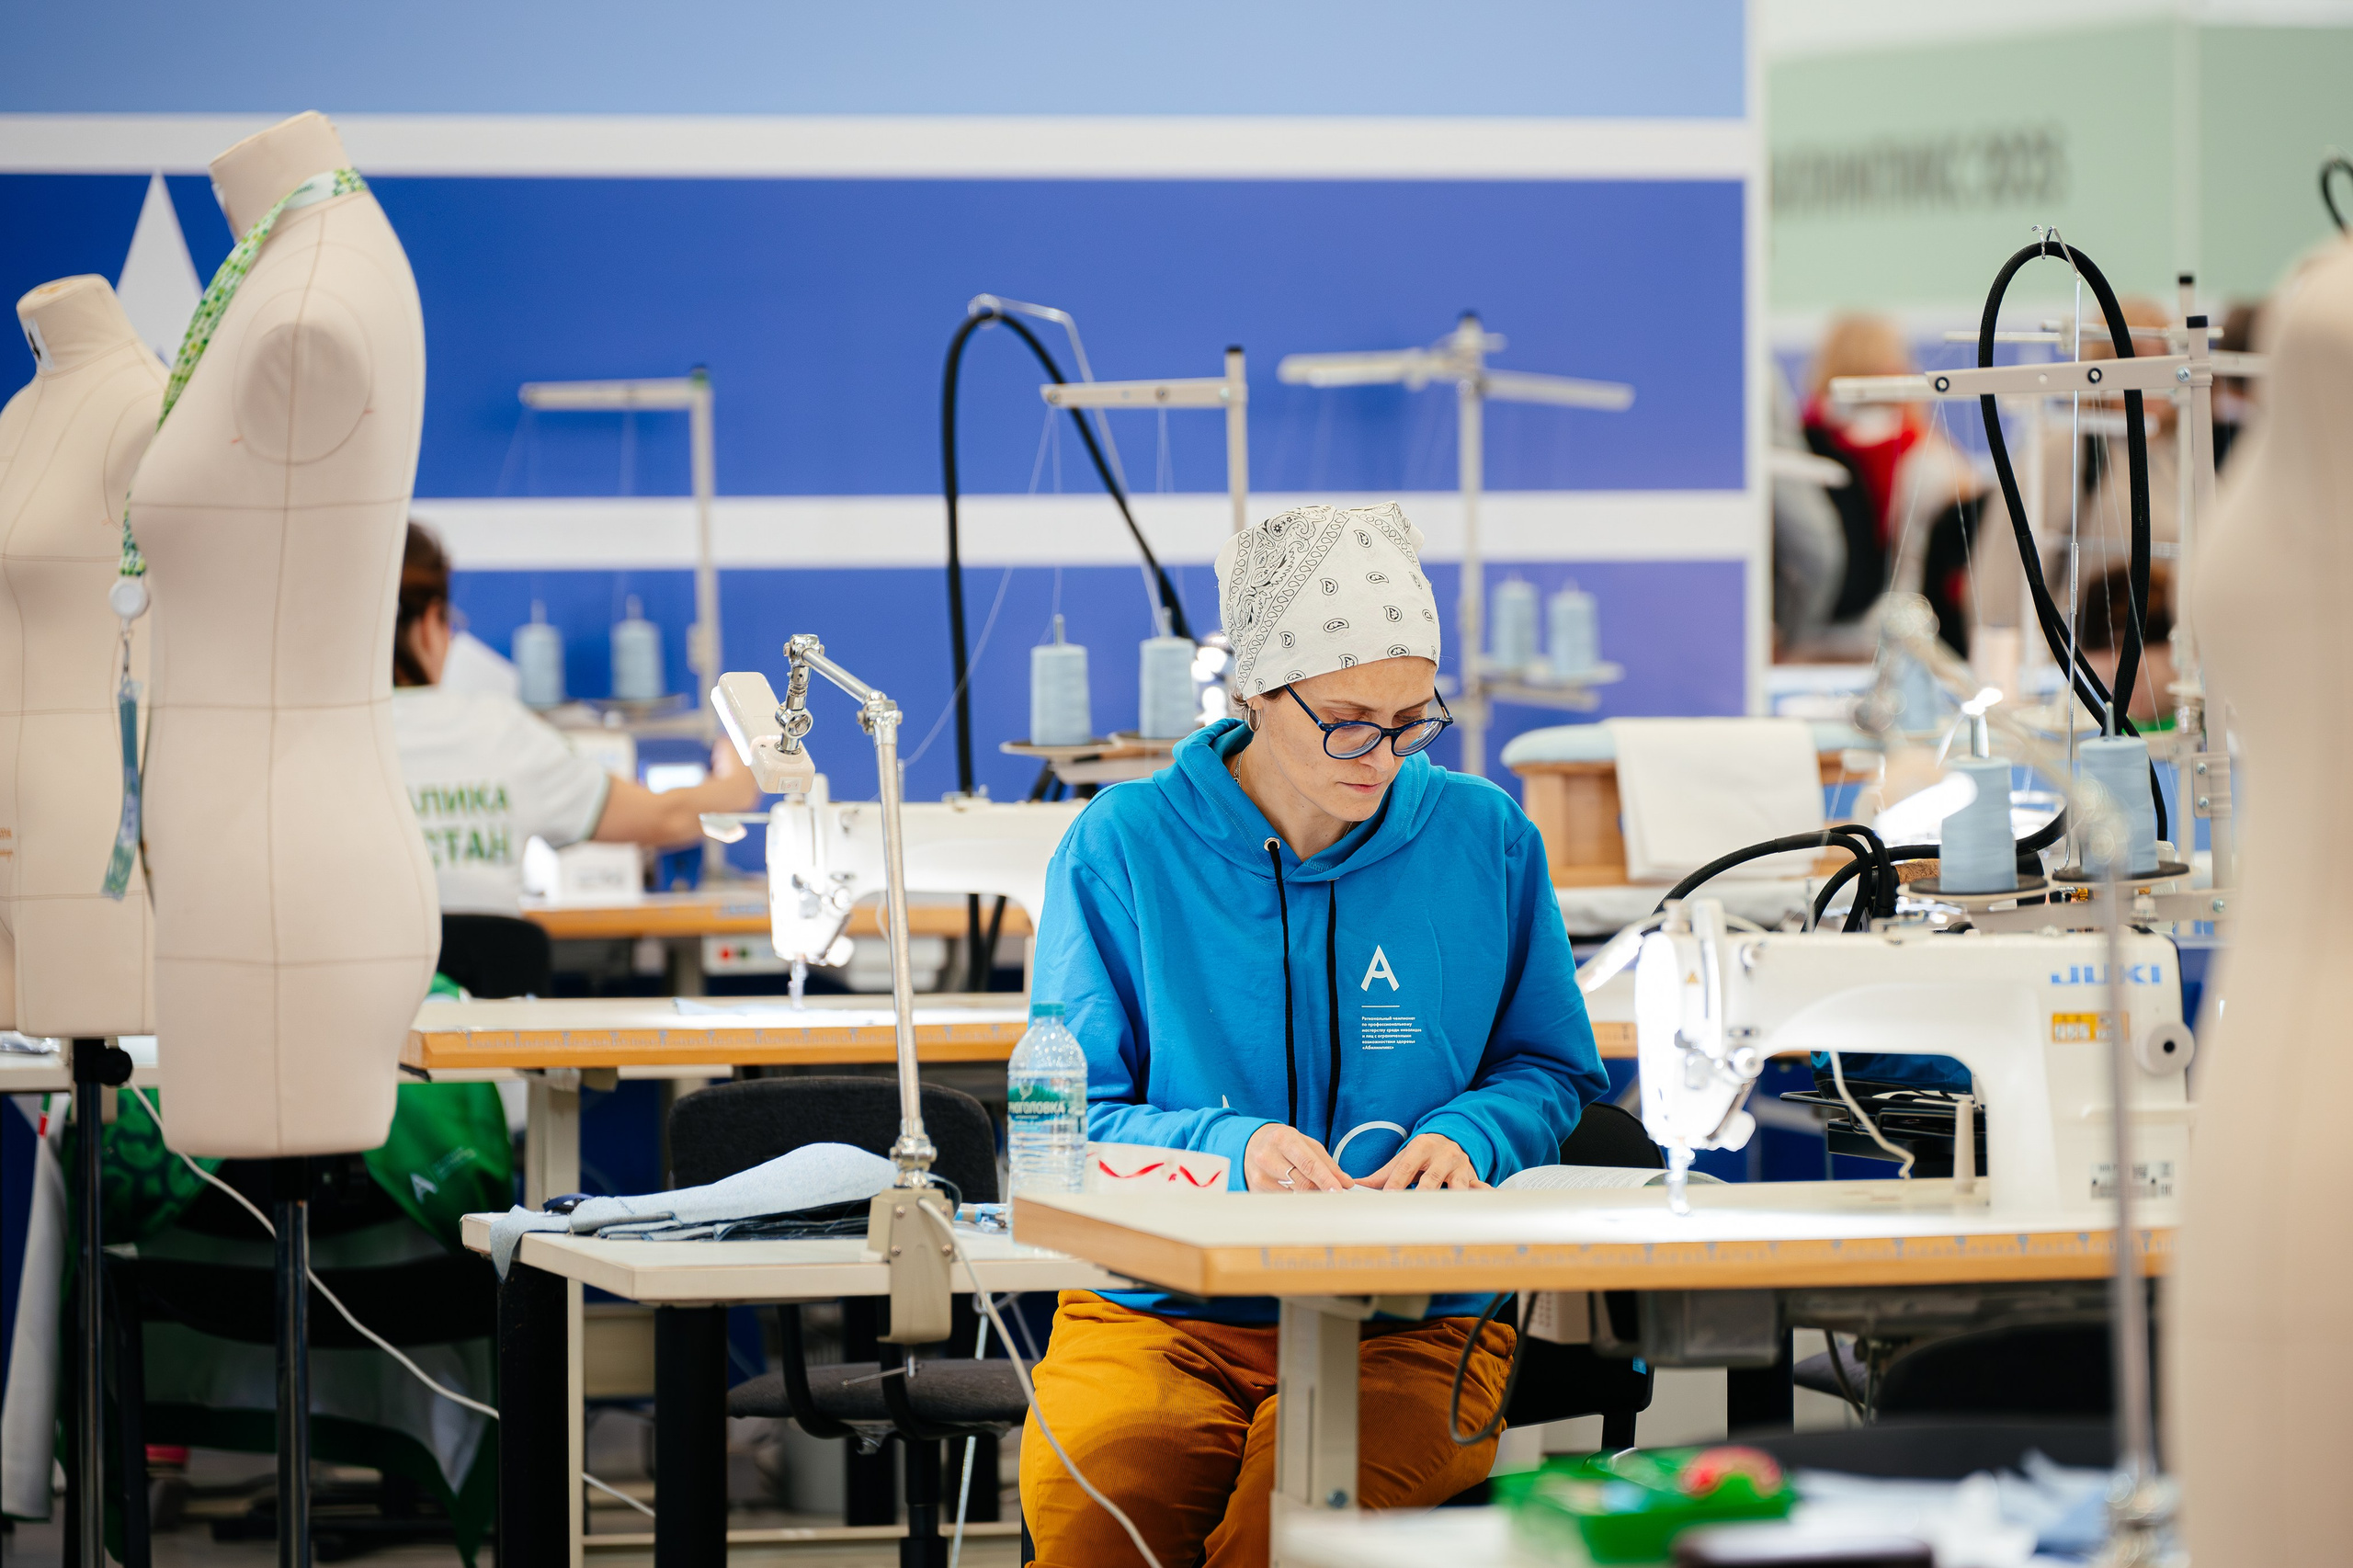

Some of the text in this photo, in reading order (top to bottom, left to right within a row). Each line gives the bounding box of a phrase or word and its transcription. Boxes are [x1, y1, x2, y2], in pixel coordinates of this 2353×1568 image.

[406, 784, 510, 814] ЛИКА
[2051, 964, 2161, 984] JUKI
[1008, 1101, 1066, 1115] НОГОЛОВКА
